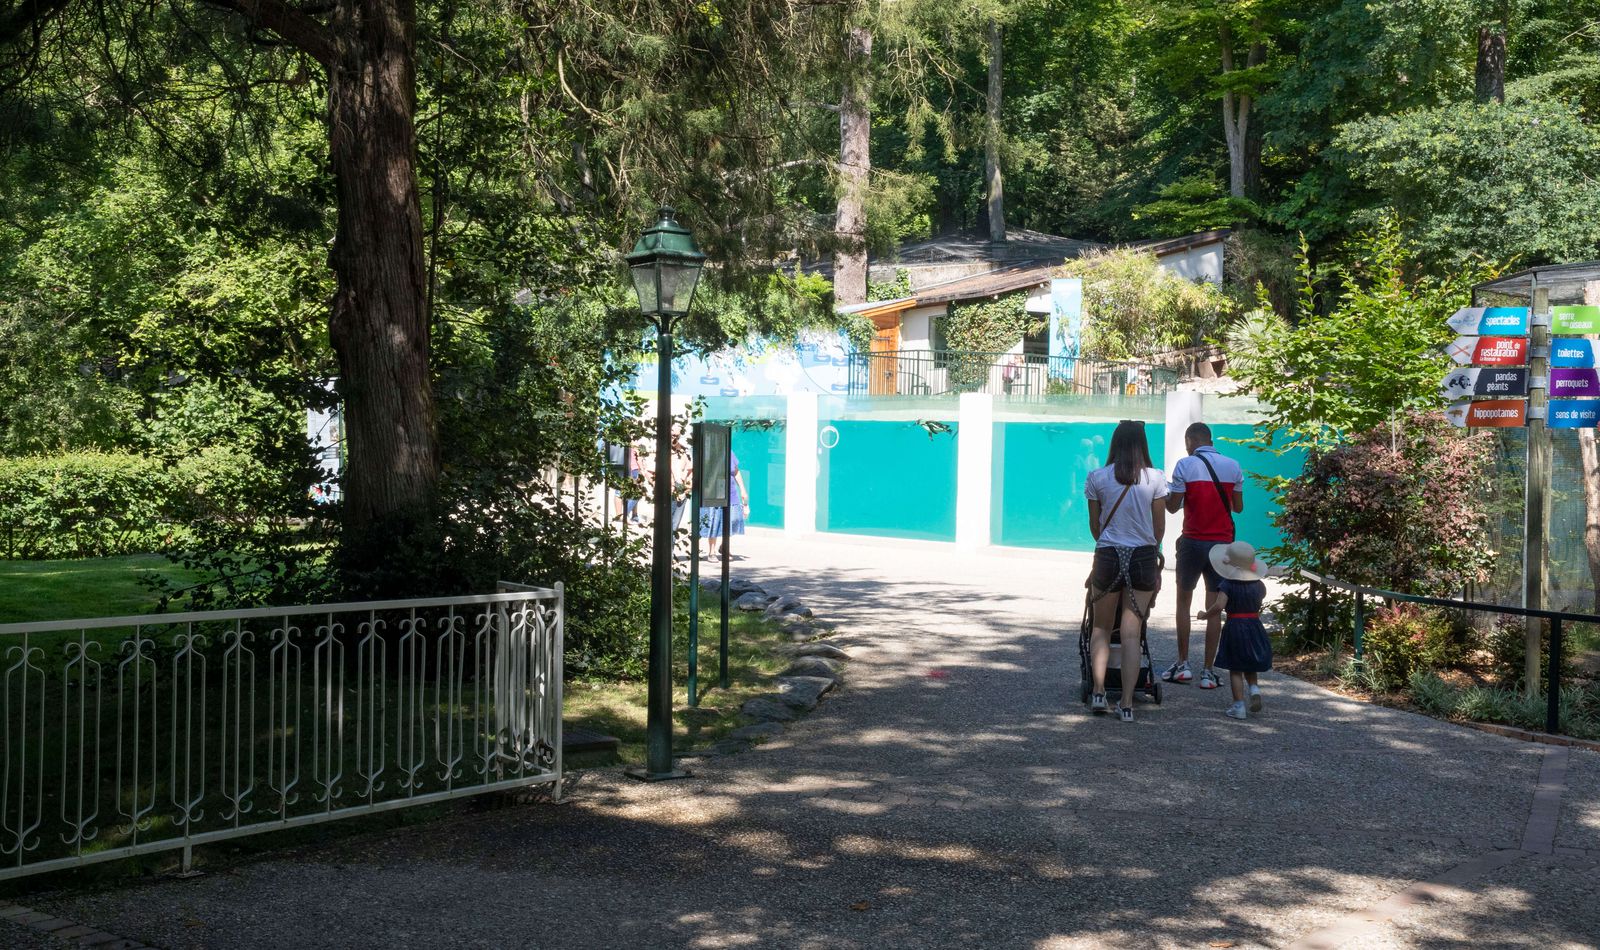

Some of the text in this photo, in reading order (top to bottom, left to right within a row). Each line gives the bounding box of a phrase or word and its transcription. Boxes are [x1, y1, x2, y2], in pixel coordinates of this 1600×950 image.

[1486, 315, 1520, 327] spectacles
[1496, 339, 1513, 349] point
[1481, 348, 1518, 357] restauration
[1557, 349, 1584, 358] toilettes
[1496, 372, 1517, 382] pandas
[1487, 382, 1508, 392] géants
[1556, 379, 1588, 389] perroquets
[1474, 408, 1518, 419] hippopotames
[1571, 410, 1578, 418] de
[1580, 410, 1595, 418] visite
